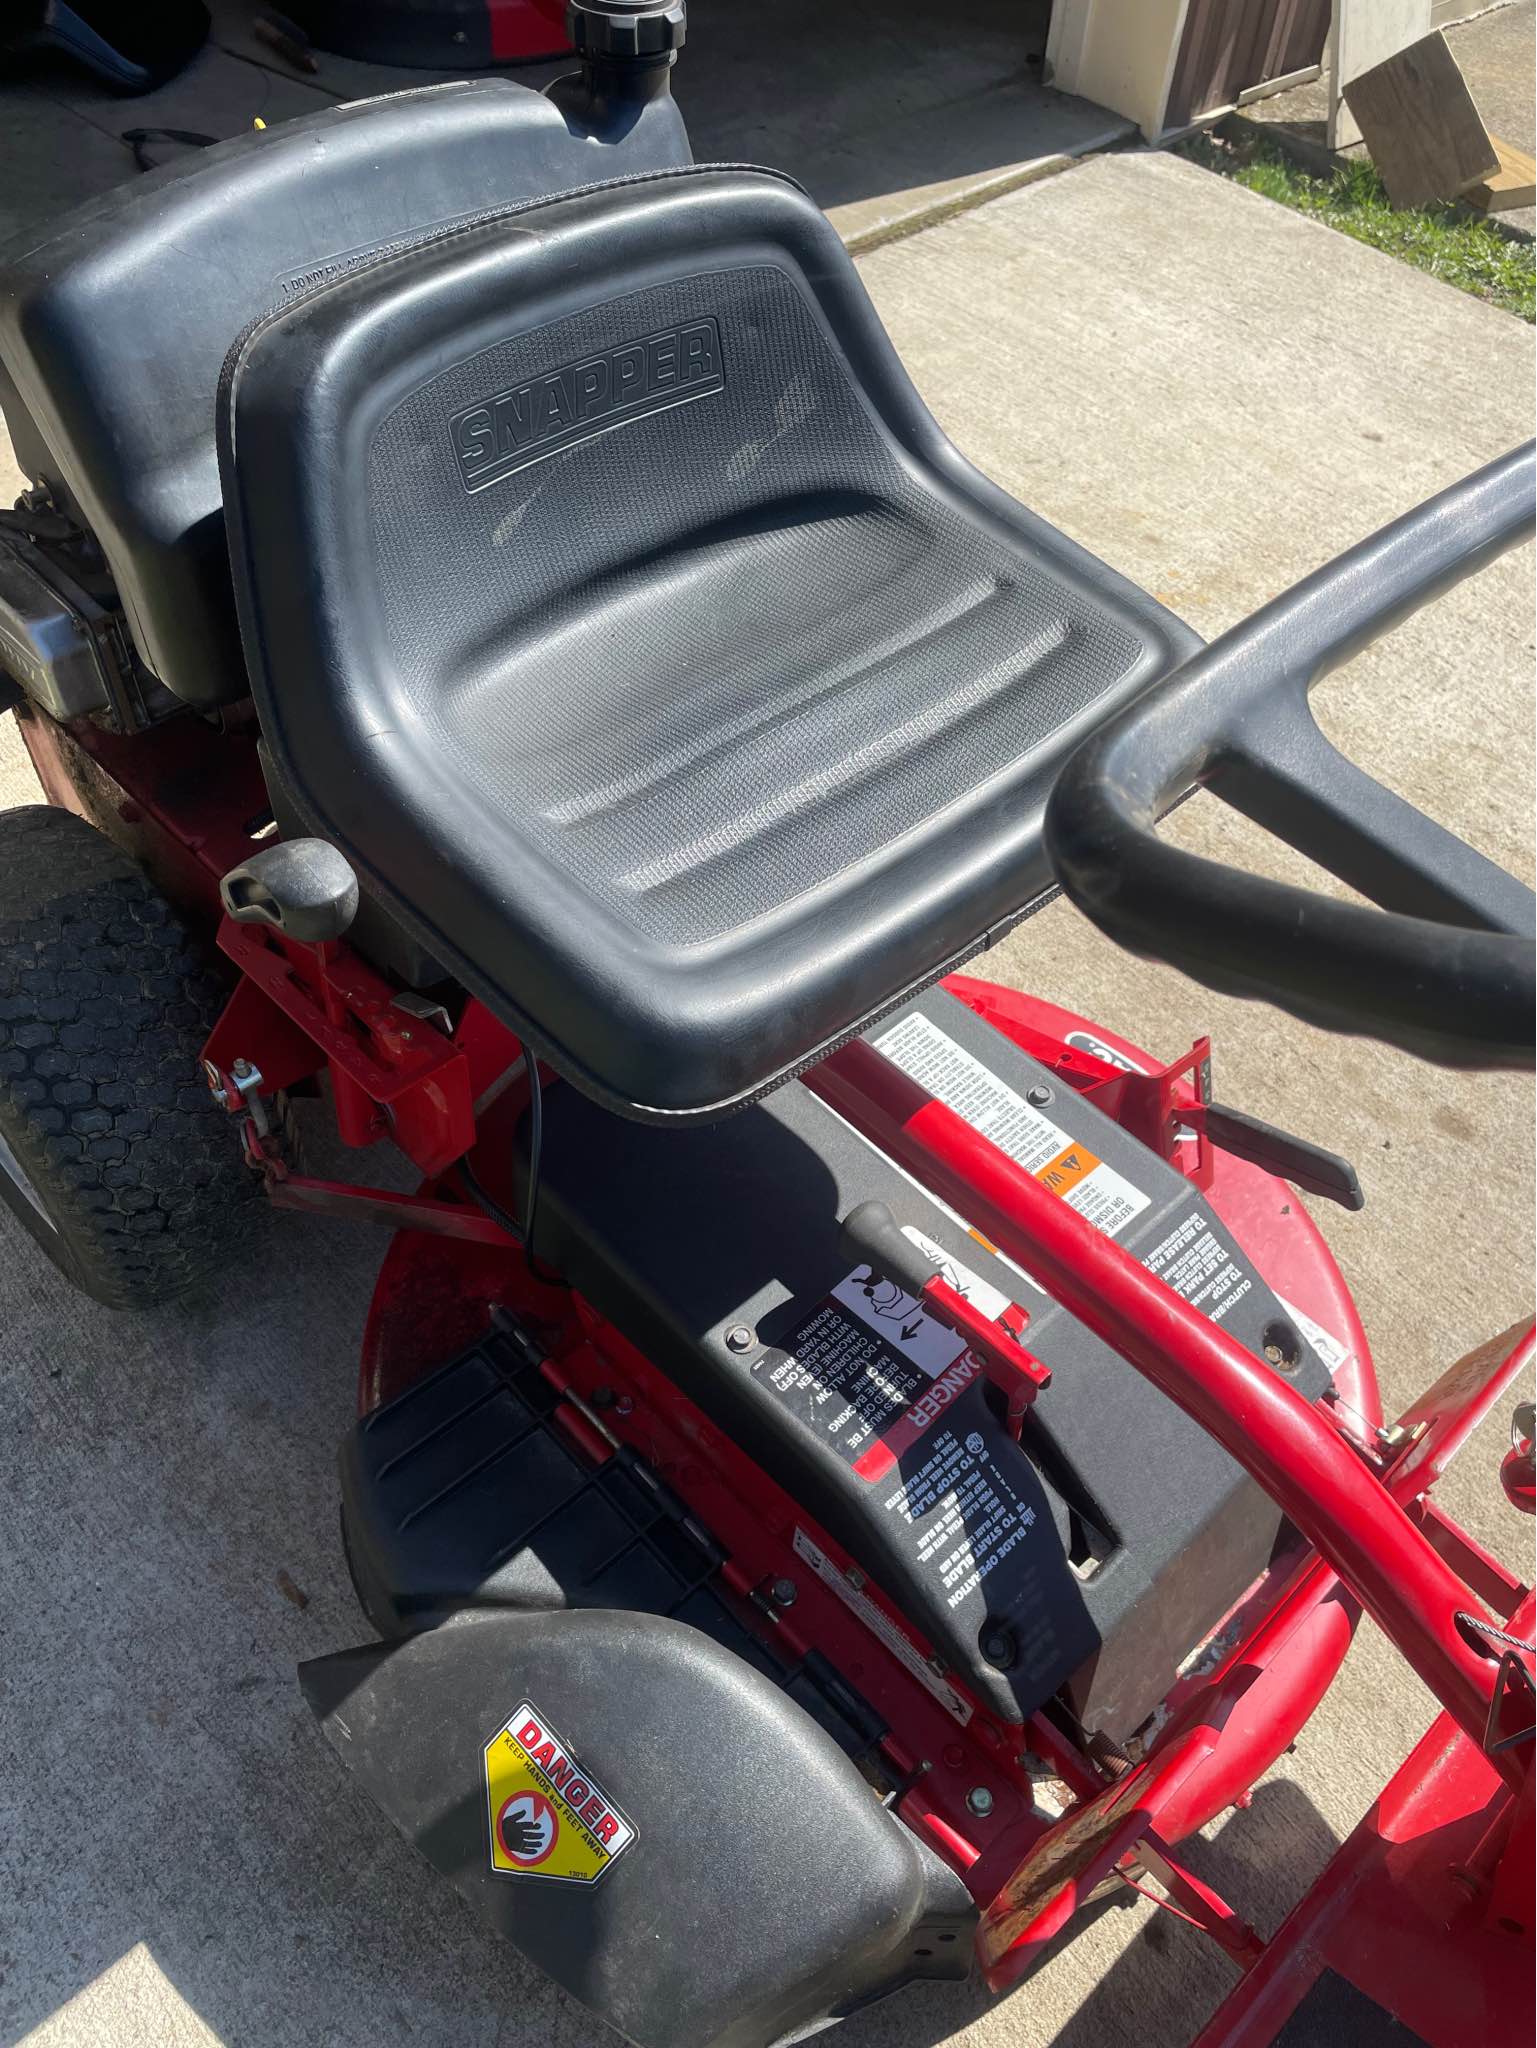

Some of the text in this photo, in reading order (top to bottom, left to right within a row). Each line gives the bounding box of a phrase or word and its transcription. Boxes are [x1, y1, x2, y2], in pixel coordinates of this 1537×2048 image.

[290, 276, 305, 291] DO
[458, 324, 714, 470] SNAPPER
[1105, 1202, 1134, 1229] BEFORE
[1110, 1196, 1124, 1209] OR
[1194, 1216, 1207, 1231] TO
[1162, 1226, 1196, 1260] RELEASE
[1216, 1248, 1228, 1262] TO
[1182, 1271, 1204, 1294] PARK
[1201, 1258, 1218, 1276] SET
[1229, 1267, 1241, 1281] TO
[1210, 1277, 1231, 1300] STOP
[796, 1307, 833, 1342] MOWING
[816, 1326, 829, 1337] IN
[826, 1314, 842, 1328] OR
[774, 1321, 851, 1392] WITH BLADES OFF)
[794, 1334, 820, 1359] YARD
[795, 1328, 860, 1389] MACHINE (EVEN
[811, 1336, 868, 1390] CHILDREN ON
[768, 1356, 797, 1382] WHEN
[813, 1343, 877, 1404] DO NOT ALLOW
[850, 1354, 890, 1393] MACHINE
[826, 1362, 899, 1433] BEFORE BACKING
[846, 1377, 918, 1448] BLADES MUST BE
[855, 1369, 908, 1423] TURNED OFF
[941, 1429, 952, 1440] TO
[884, 1437, 958, 1510] PEDAL OR SHIFT BLADE LEVER
[896, 1446, 964, 1513] REMOVE HEEL FROM BLADE
[903, 1453, 974, 1524] TO STOP BLADE
[955, 1484, 965, 1496] TO
[962, 1469, 981, 1488] PEDAL
[916, 1478, 987, 1549] KEEP EITHER HEEL OR BLADE
[983, 1495, 1000, 1514] HOLD.
[916, 1486, 994, 1564] PUSH BLADE PEDAL WITH HEEL.
[995, 1525, 1027, 1558] BLADE
[941, 1511, 1016, 1588] TO START BLADE
[946, 1553, 999, 1608] OPERATION
[503, 1737, 606, 1860] KEEP HANDS and FEET AWAY
[516, 1719, 619, 1845] DANGER
